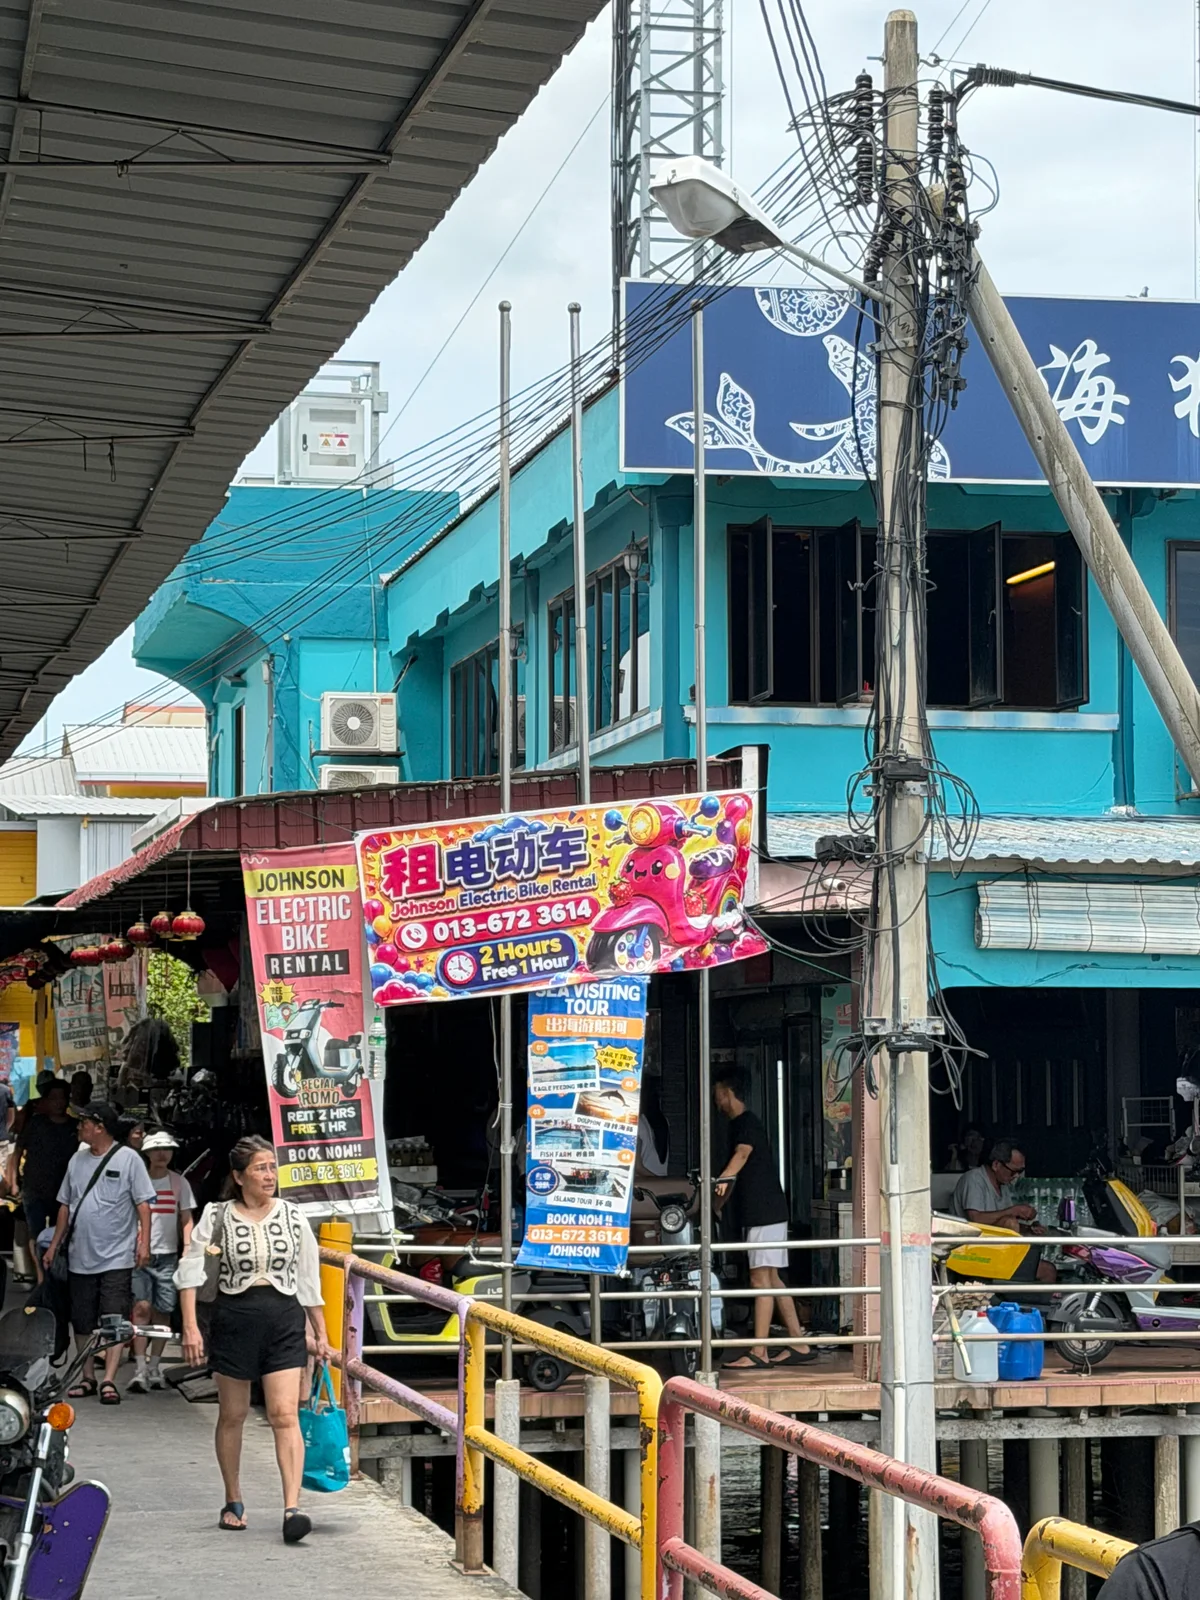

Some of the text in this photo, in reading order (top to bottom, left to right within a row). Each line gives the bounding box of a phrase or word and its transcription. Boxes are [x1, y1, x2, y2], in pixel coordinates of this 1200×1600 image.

[382, 825, 589, 898] 租电动车
[257, 869, 345, 892] JOHNSON
[391, 873, 597, 919] Johnson Electric Bike Rental
[256, 895, 352, 925] ELECTRIC
[433, 901, 592, 942] 013-672 3614
[281, 924, 329, 951] BIKE
[479, 937, 562, 966] 2 Hours
[270, 953, 344, 975] RENTAL
[482, 954, 569, 981] Free 1 Hour
[573, 983, 641, 1001] VISITING
[565, 998, 609, 1016] TOUR
[287, 1107, 356, 1122] RET 2 HRS
[290, 1121, 347, 1135] FRE 1 HR
[553, 1195, 593, 1205] ISLAND TOUR
[547, 1213, 577, 1225] BOOK
[531, 1228, 623, 1243] 013-672 3614
[547, 1245, 600, 1258] JOHNSON
